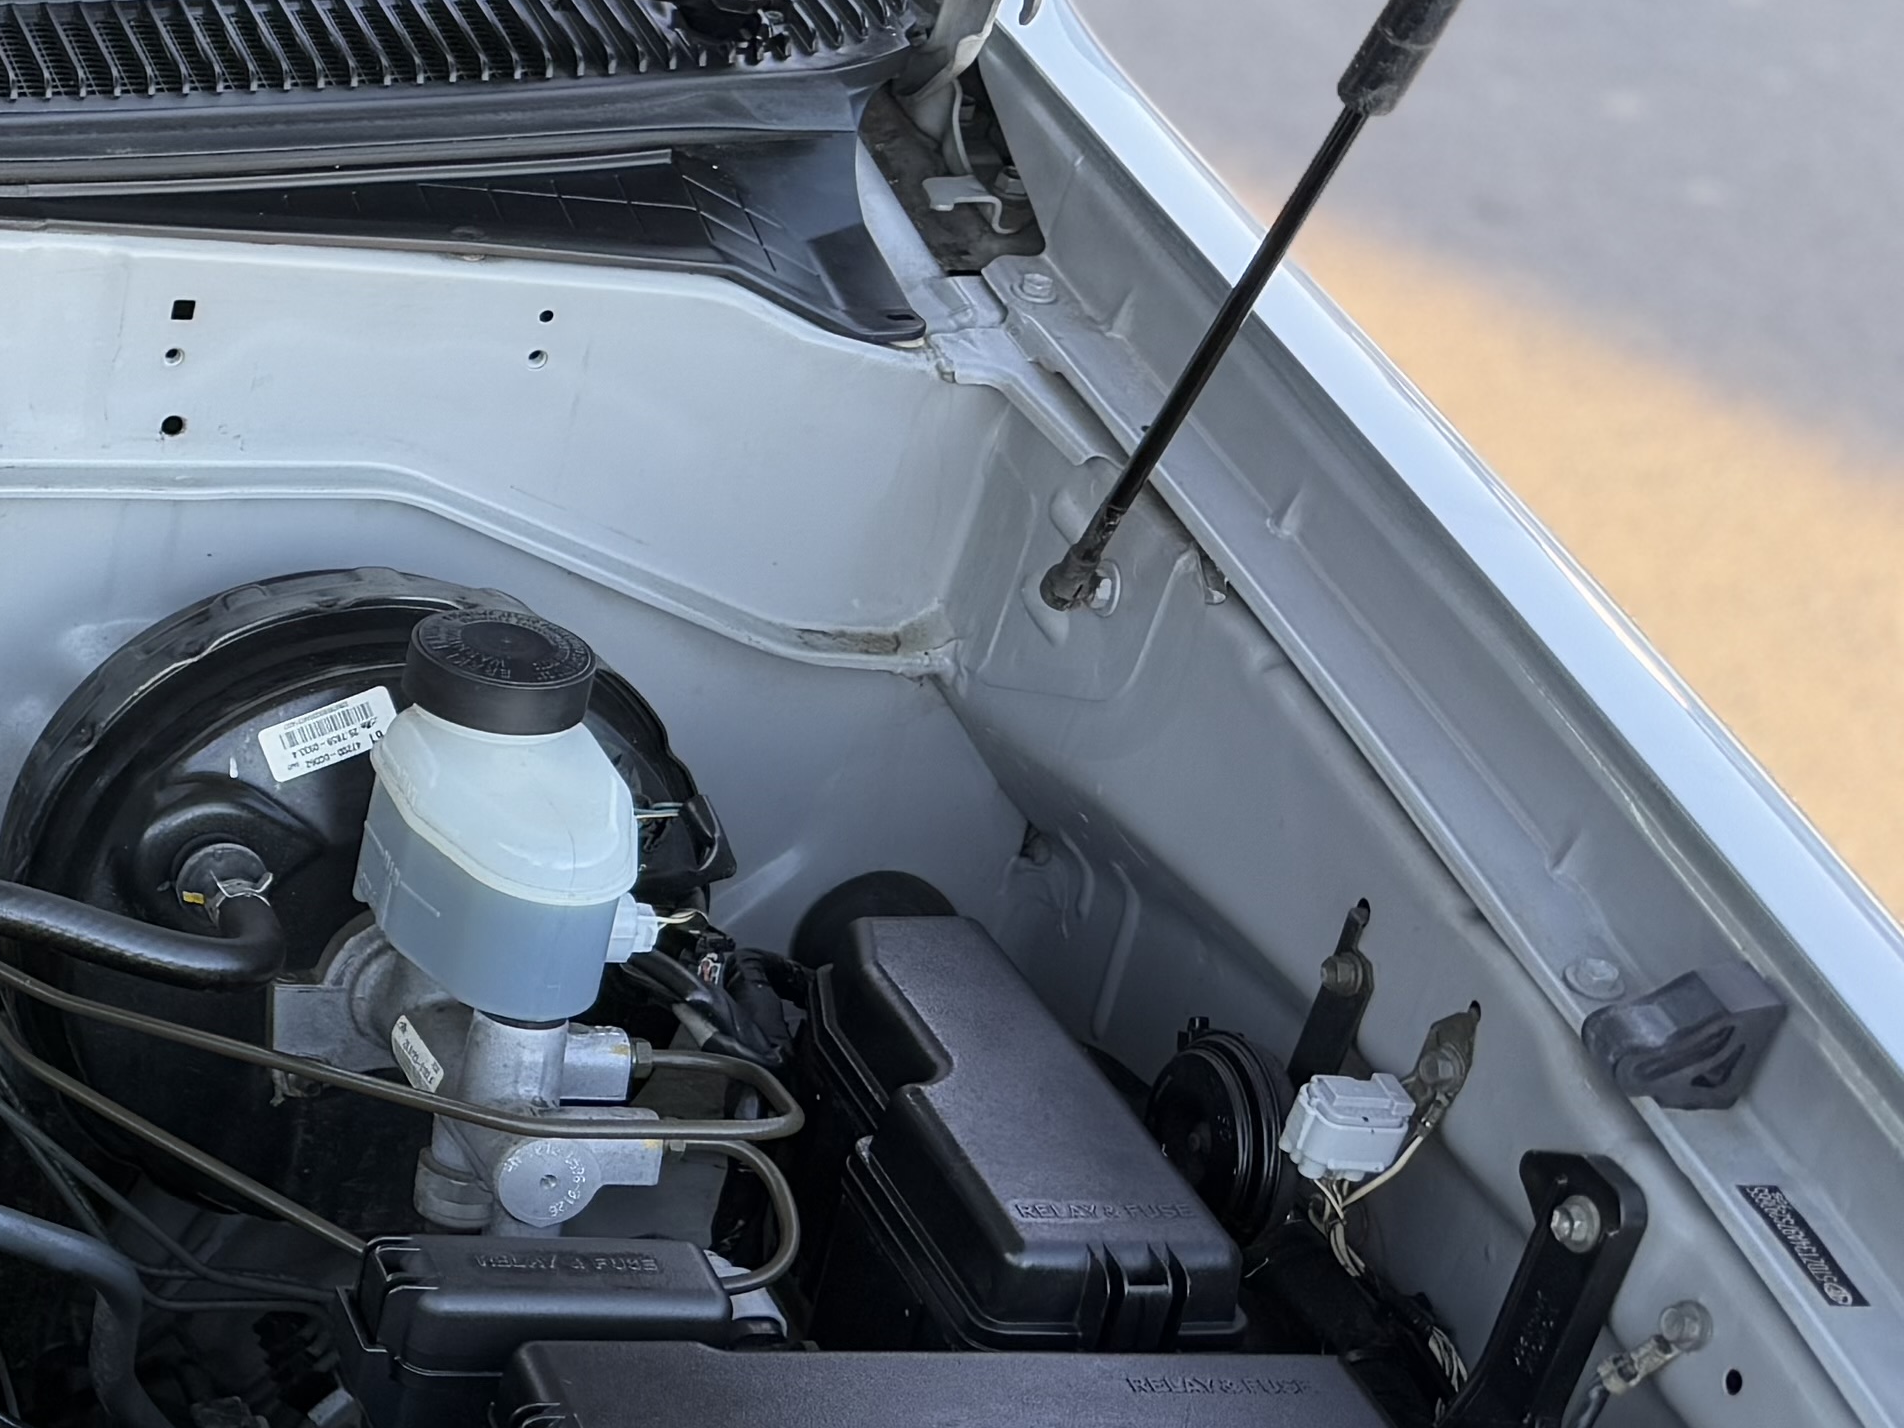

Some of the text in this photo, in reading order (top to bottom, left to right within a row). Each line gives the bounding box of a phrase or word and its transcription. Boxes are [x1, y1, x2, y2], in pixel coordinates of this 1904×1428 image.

[1016, 1203, 1098, 1220] RELAY
[1125, 1204, 1199, 1219] FUSE
[593, 1257, 659, 1271] FUSE
[1126, 1377, 1214, 1394] RELAY
[1243, 1378, 1311, 1394] FUSE
